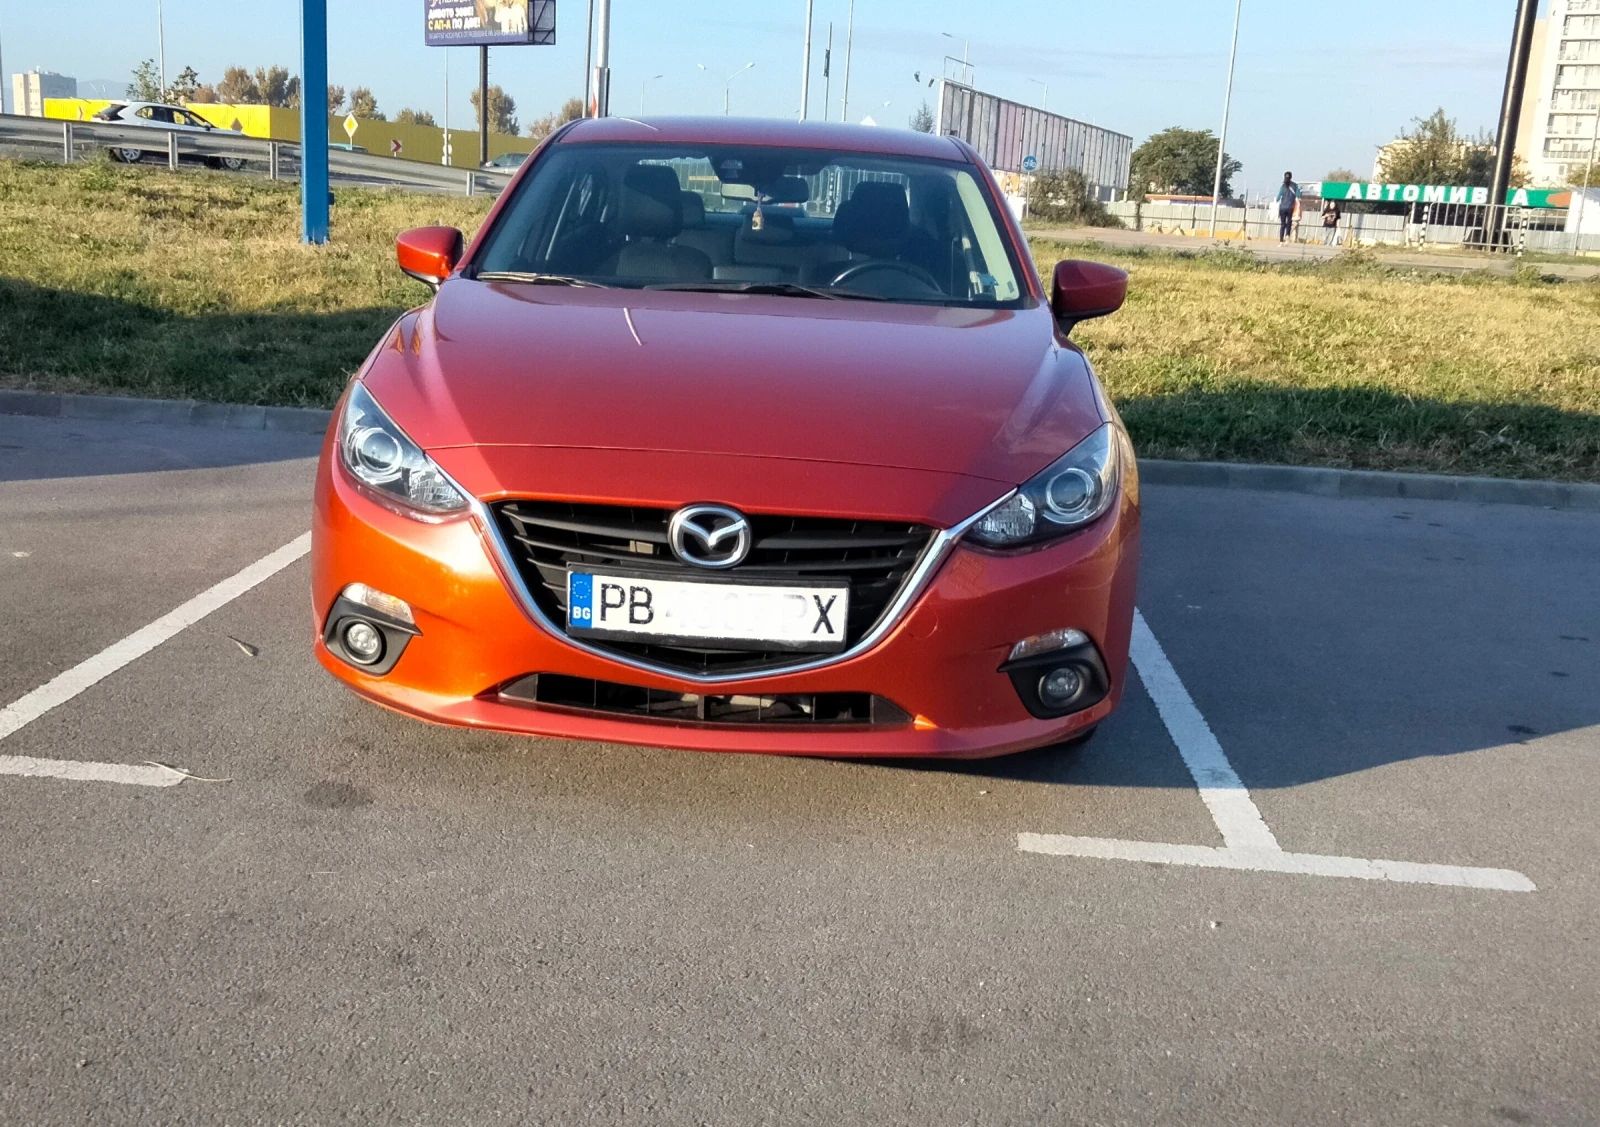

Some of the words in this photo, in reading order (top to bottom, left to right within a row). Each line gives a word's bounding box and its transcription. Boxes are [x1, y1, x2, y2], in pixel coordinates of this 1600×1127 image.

[452, 18, 463, 29] ПО
[1345, 182, 1529, 206] АВТОМИВА
[572, 606, 591, 620] BG
